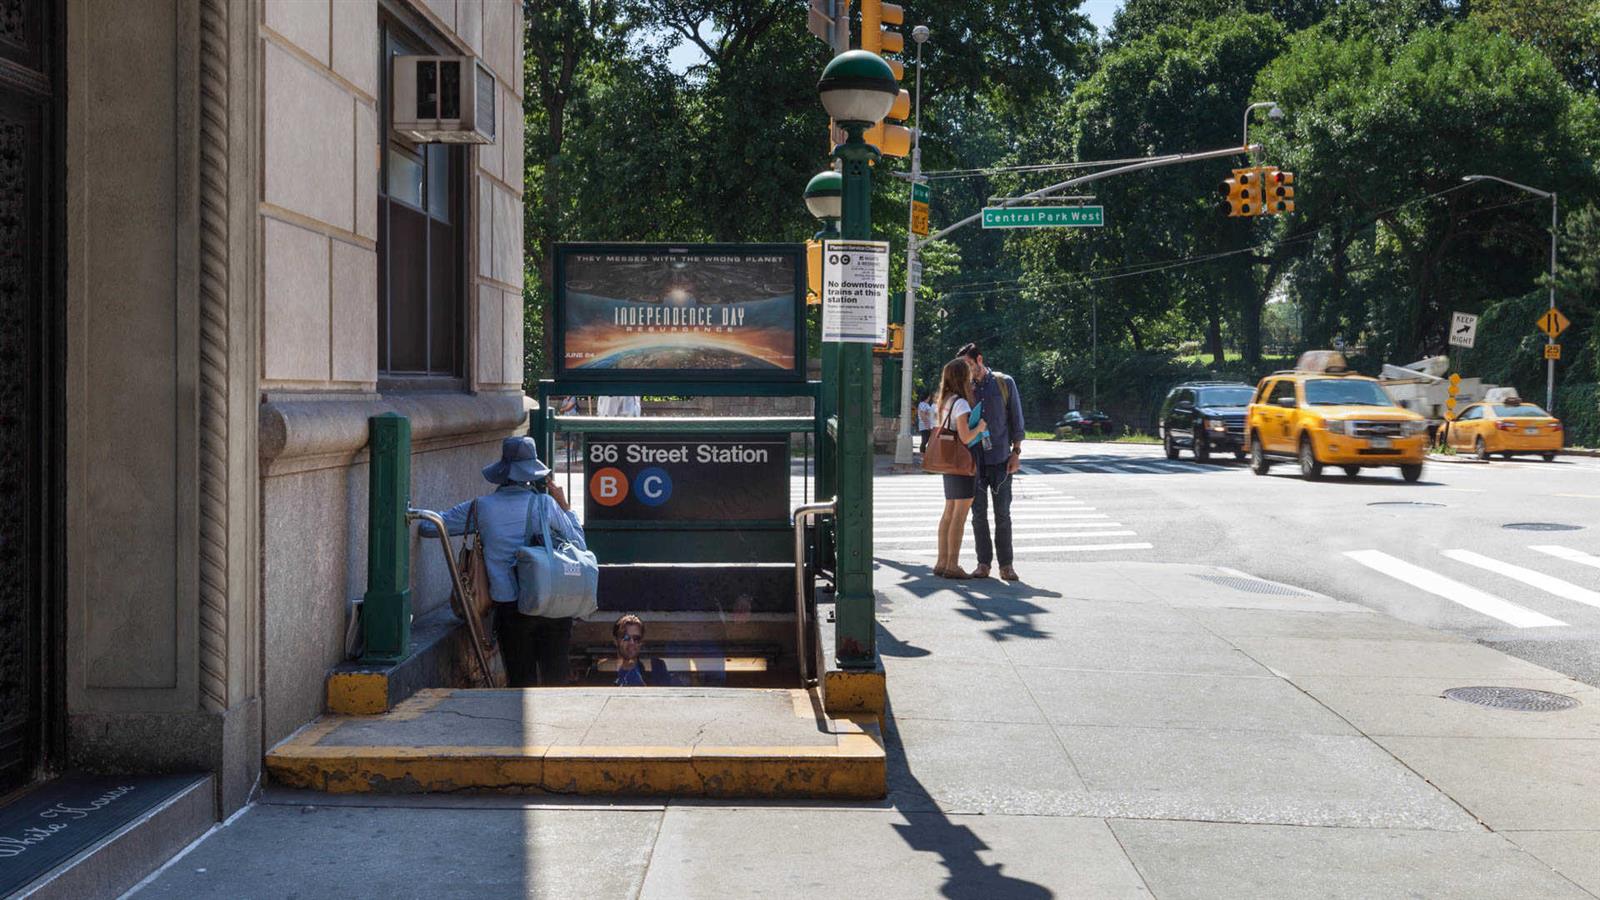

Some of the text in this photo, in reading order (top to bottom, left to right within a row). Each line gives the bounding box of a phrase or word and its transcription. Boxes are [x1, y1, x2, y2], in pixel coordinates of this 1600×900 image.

[986, 211, 1100, 222] Central Park West
[828, 280, 885, 289] No downtown
[865, 289, 881, 297] this
[828, 296, 857, 304] station
[614, 307, 745, 326] INDEPENDENCE DAY
[1456, 315, 1475, 324] KEEP
[1451, 335, 1473, 345] RIGHT
[590, 444, 768, 463] 86 Street Station
[600, 476, 663, 498] B C
